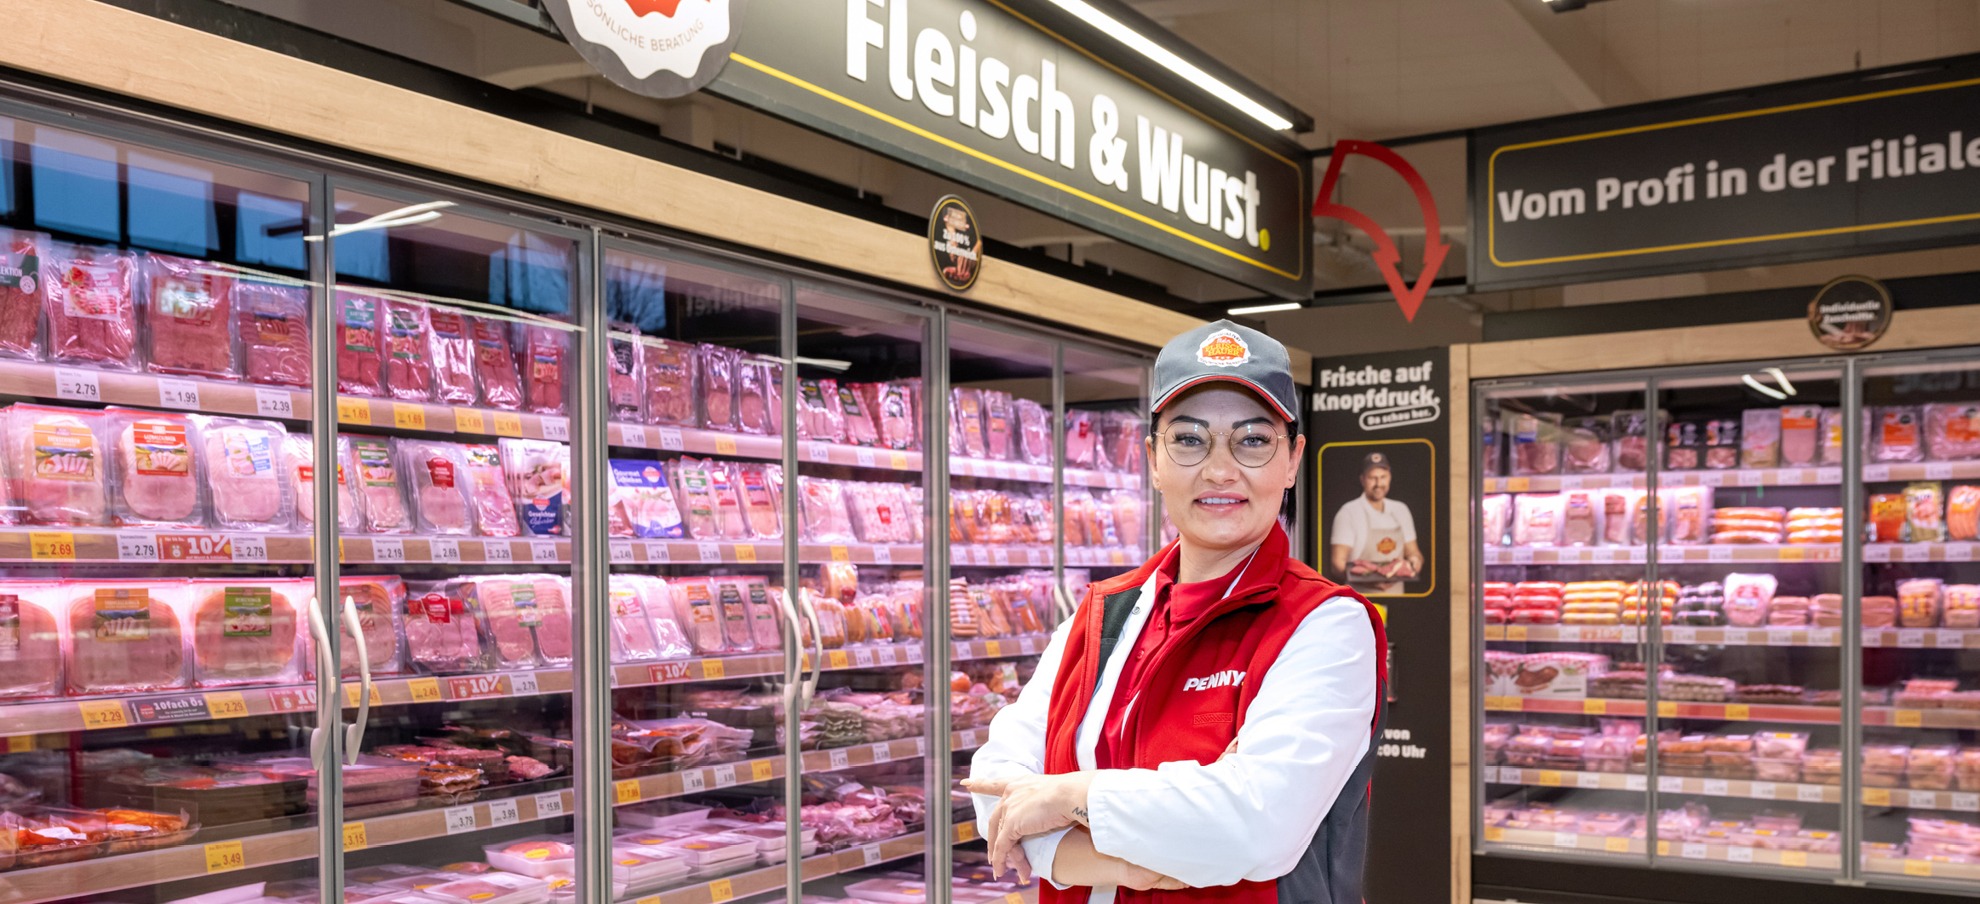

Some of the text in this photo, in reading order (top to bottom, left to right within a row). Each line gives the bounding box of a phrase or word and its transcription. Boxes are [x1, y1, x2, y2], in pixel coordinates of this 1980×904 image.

[651, 18, 704, 51] BERATUNG
[846, 0, 1270, 251] Fleisch & Wurst.
[1498, 187, 1585, 222] Vom
[1597, 163, 1695, 210] Profi
[1707, 160, 1747, 198] in
[1758, 153, 1835, 192] der
[1320, 361, 1432, 388] Frische auf
[75, 383, 97, 396] 2.79
[177, 391, 197, 403] 1.99
[1313, 385, 1440, 413] Knopfdruck.
[272, 400, 290, 412] 2.39
[352, 408, 368, 420] 1.69
[407, 413, 422, 425] 1.69
[50, 543, 72, 556] 2.69
[135, 545, 155, 556] 2.79
[187, 533, 231, 555] 10%
[247, 546, 264, 557] 2.79
[387, 548, 402, 558] 2.19
[665, 662, 689, 678] 10%
[469, 674, 500, 693] 10%
[153, 699, 189, 711] 10fach
[224, 702, 243, 713] 2.29
[100, 711, 122, 723] 2.29
[1385, 729, 1410, 741] von
[1402, 745, 1426, 758] Uhr
[502, 808, 516, 820] 3.99
[459, 815, 473, 828] 3.79
[348, 833, 364, 846] 3.15
[222, 852, 241, 866] 3.49
